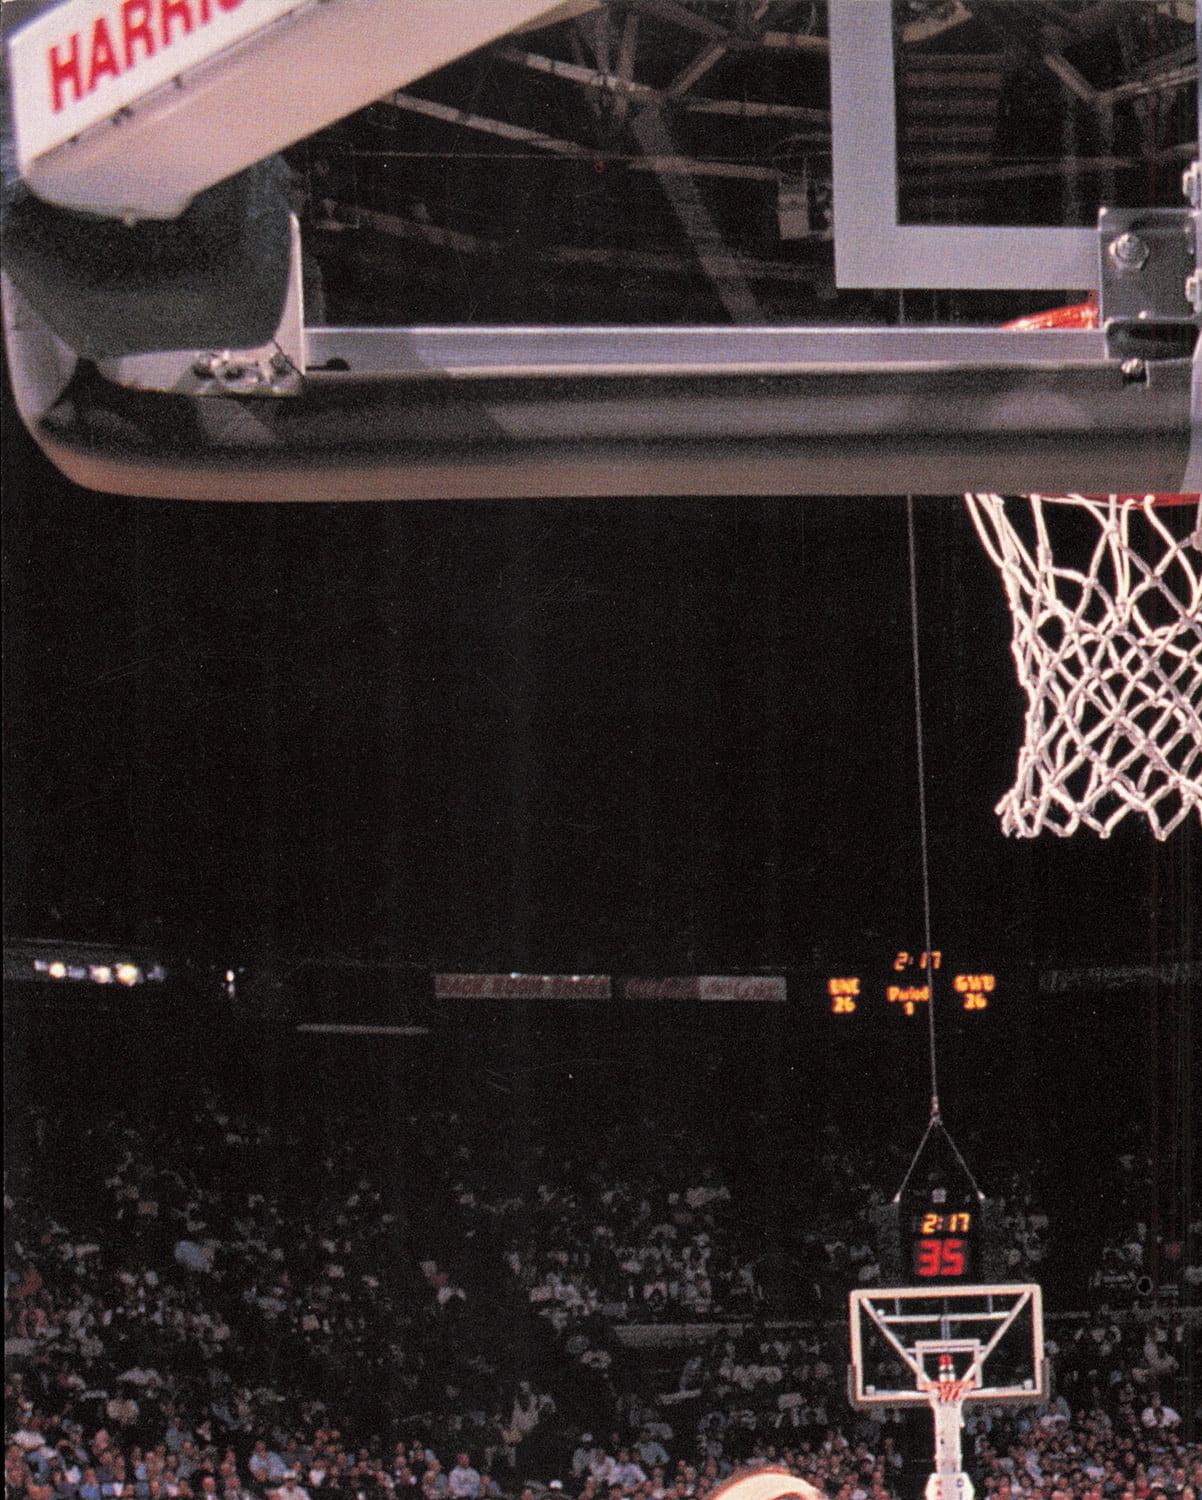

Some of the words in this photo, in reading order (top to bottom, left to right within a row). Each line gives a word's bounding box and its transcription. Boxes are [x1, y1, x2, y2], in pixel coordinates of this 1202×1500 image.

[48, 0, 244, 113] HARR
[893, 951, 941, 970] 2:17
[953, 973, 995, 992] GWU
[921, 1212, 971, 1234] 2:17
[918, 1239, 965, 1277] 35
